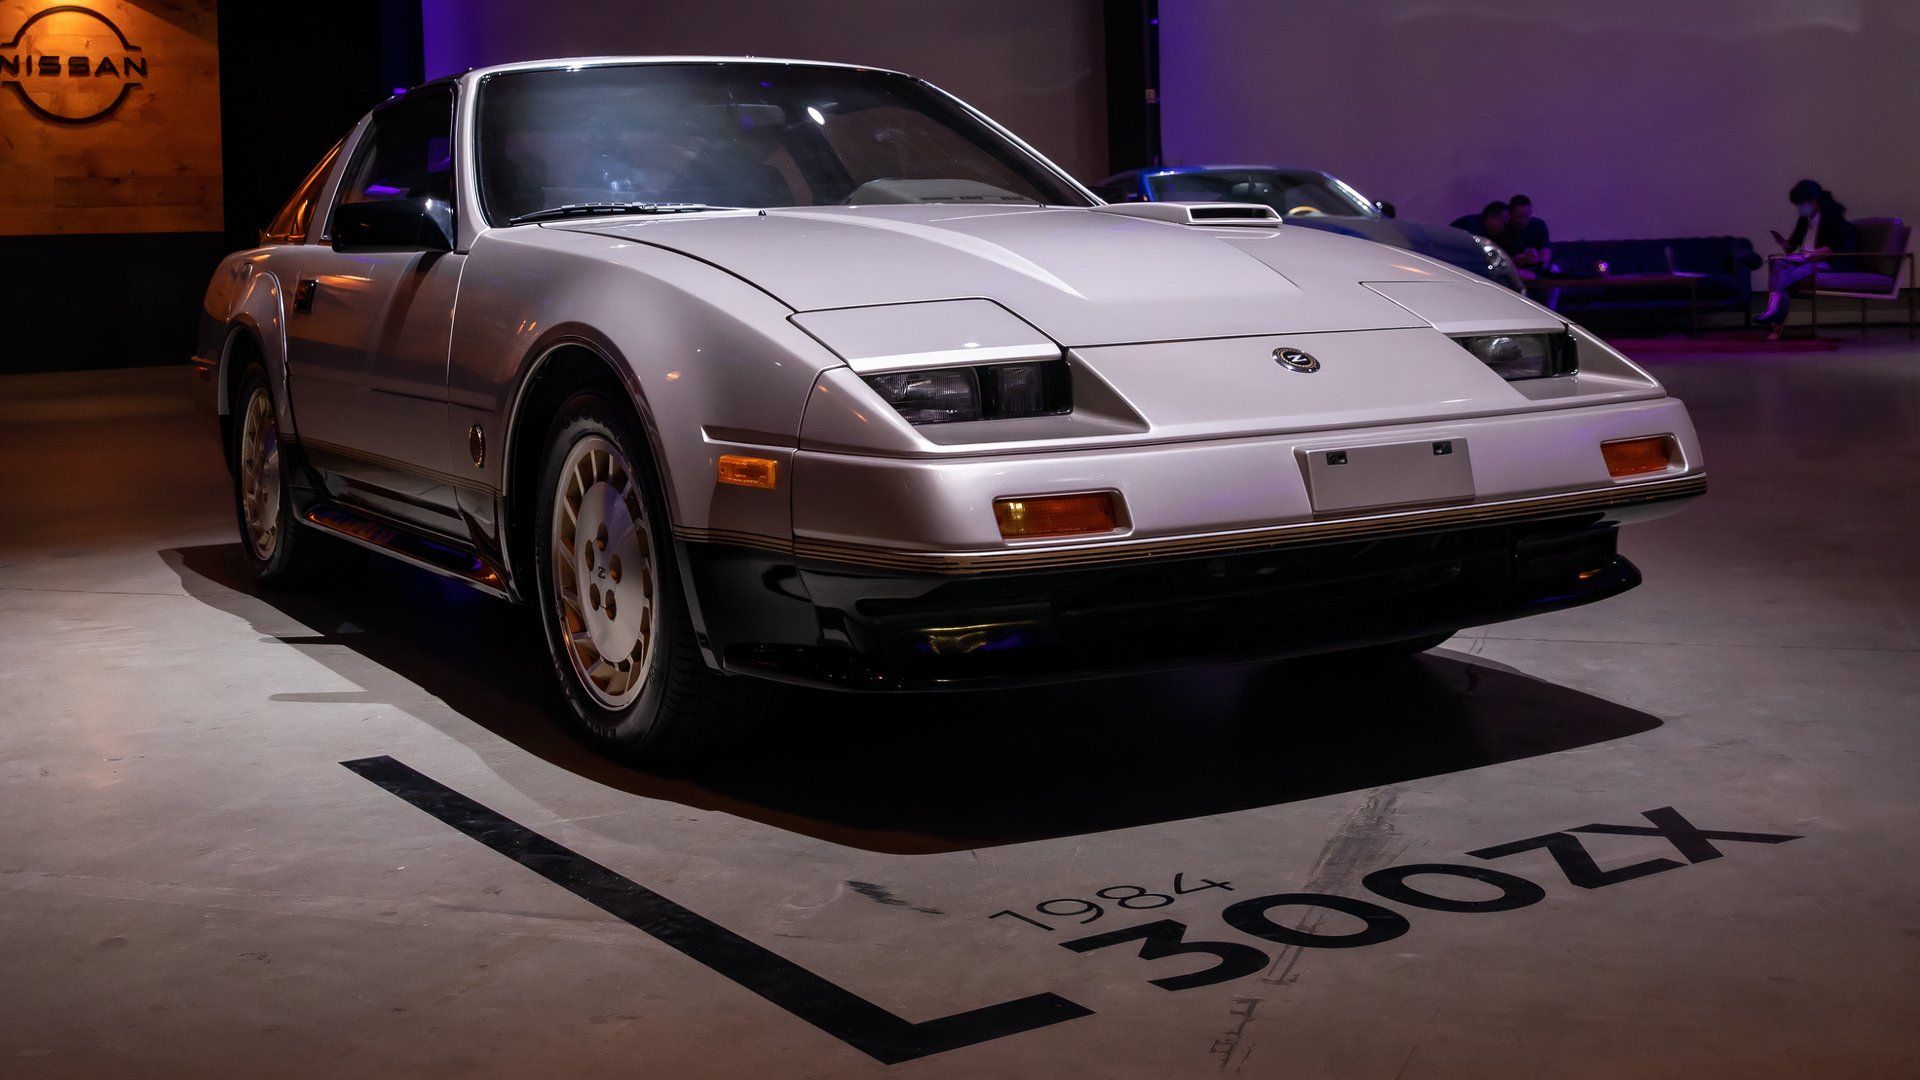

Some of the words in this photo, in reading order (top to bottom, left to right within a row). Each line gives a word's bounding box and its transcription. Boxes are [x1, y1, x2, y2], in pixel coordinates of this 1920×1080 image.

[0, 55, 148, 79] NISSAN
[988, 872, 1234, 931] 1984
[1059, 806, 1804, 991] 300ZX
